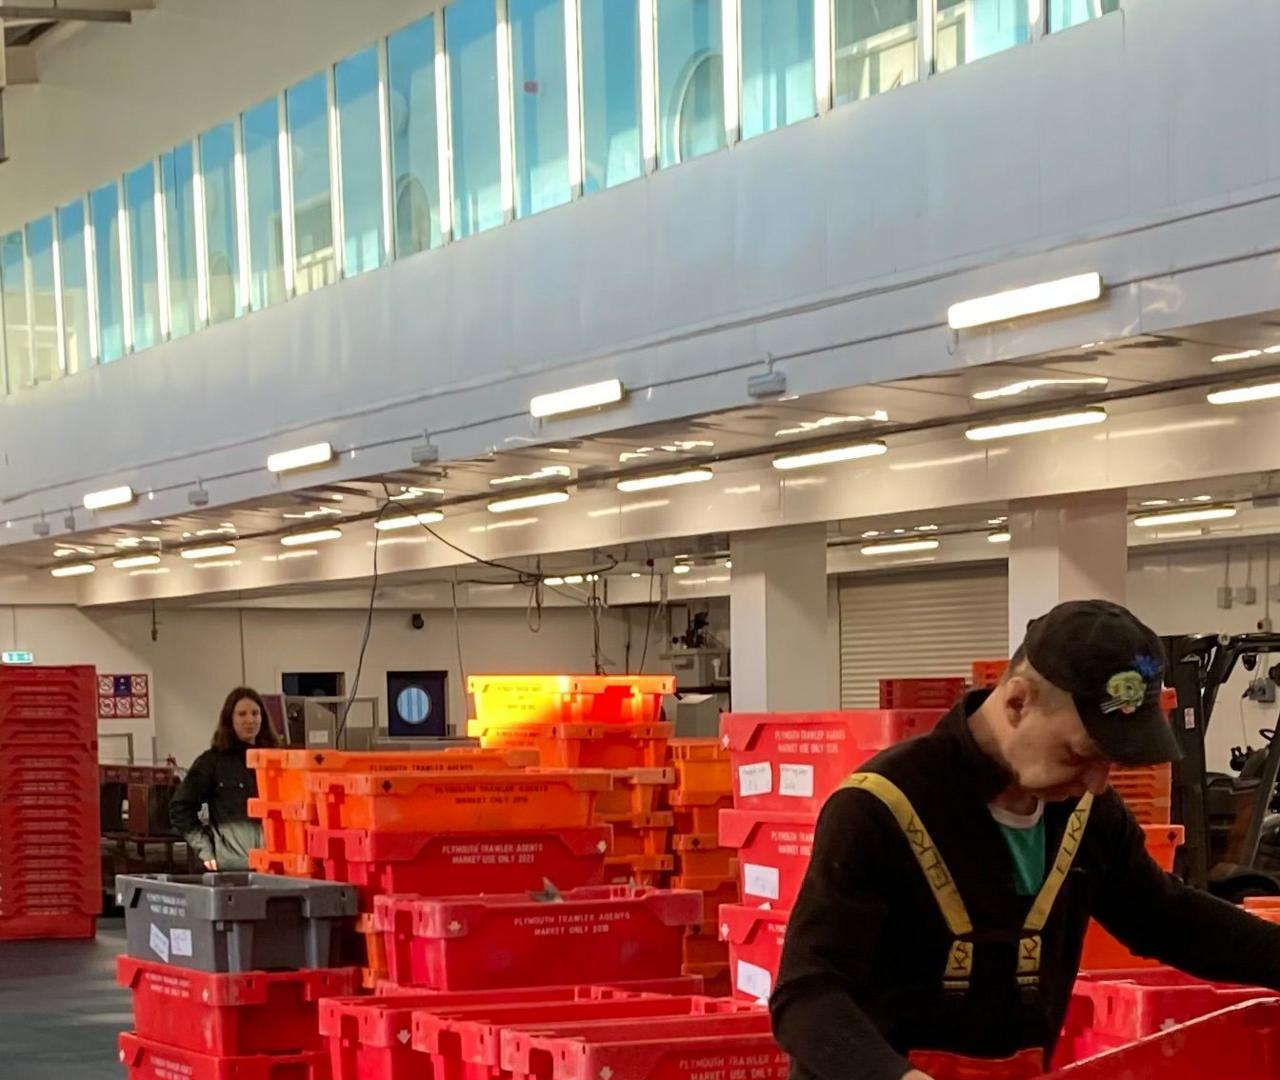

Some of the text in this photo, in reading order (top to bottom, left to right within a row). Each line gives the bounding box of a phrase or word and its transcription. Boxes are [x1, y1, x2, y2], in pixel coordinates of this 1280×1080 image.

[905, 816, 949, 890] ELKA
[452, 855, 482, 865] MARKET
[514, 916, 554, 926] PLYMOUTH
[534, 926, 565, 936] MARKET
[679, 1057, 724, 1070] PLYMOUTH
[728, 1054, 769, 1065] TRAWLER
[729, 1070, 747, 1080] USE
[751, 1068, 773, 1079] ONLY
